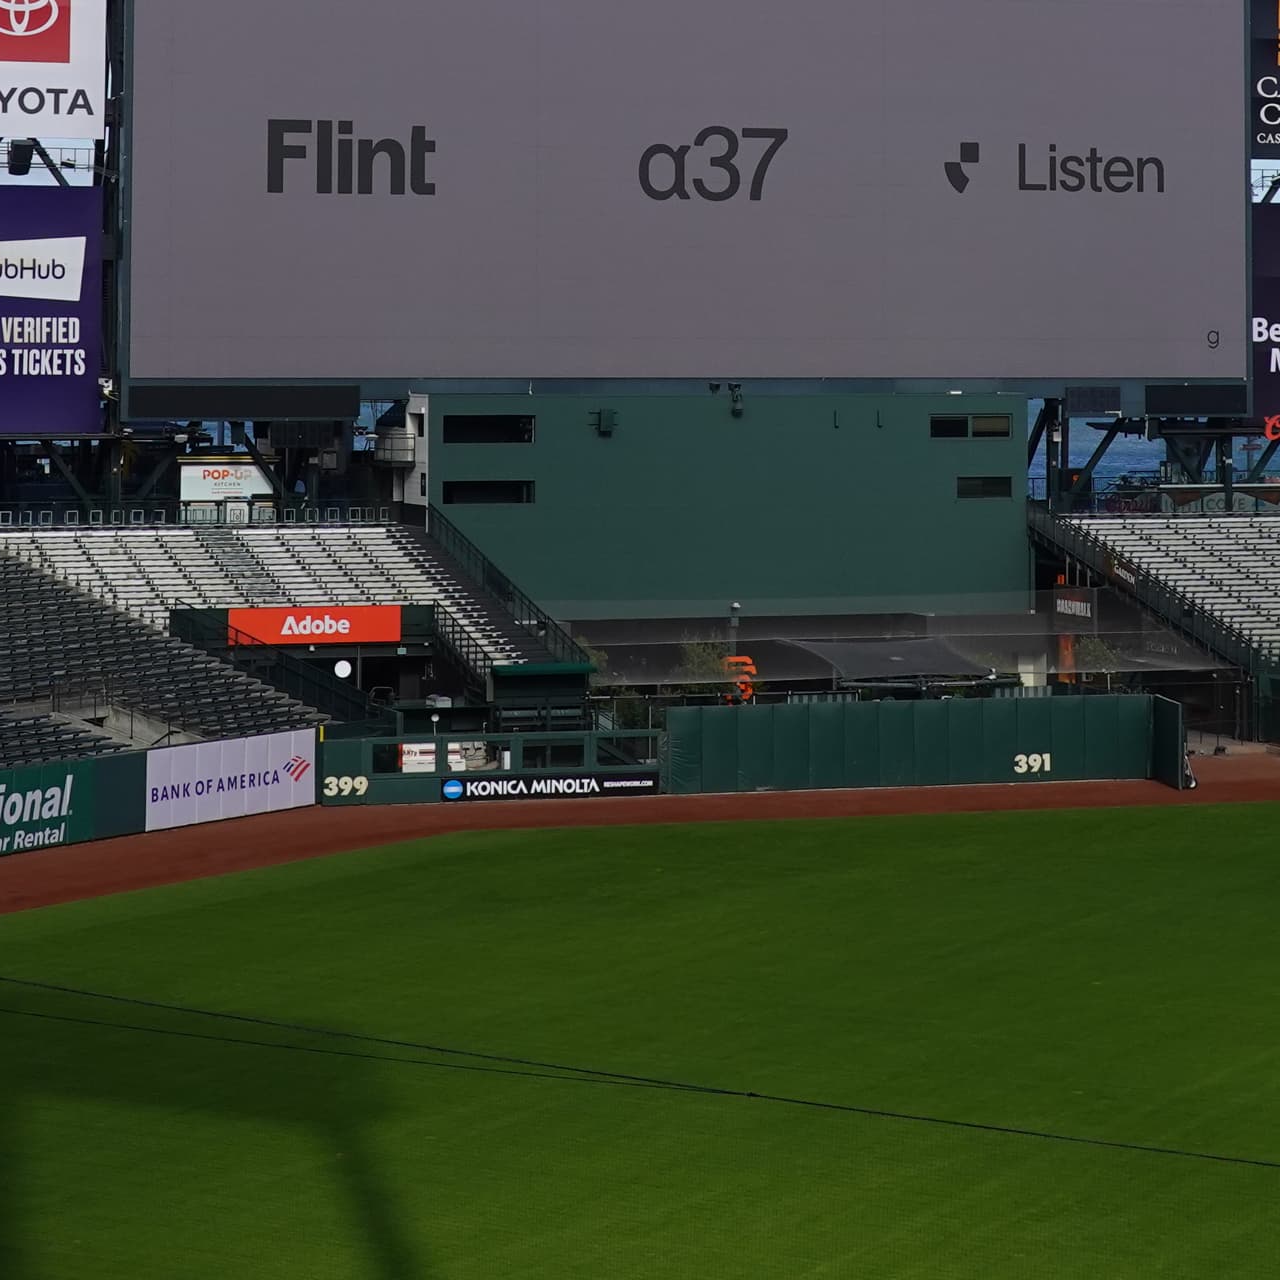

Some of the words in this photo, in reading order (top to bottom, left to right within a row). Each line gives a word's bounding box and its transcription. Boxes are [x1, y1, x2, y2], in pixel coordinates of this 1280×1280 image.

[266, 119, 436, 195] Flint
[1018, 143, 1166, 194] Listen
[0, 317, 80, 344] VERIFIED
[1206, 328, 1220, 349] g
[12, 349, 86, 376] TICKETS
[280, 615, 350, 635] Adobe
[1014, 753, 1052, 774] 391
[151, 783, 191, 804] BANK
[195, 779, 214, 796] OF
[216, 770, 281, 793] AMERICA
[323, 775, 369, 797] 399
[466, 780, 527, 797] KONICA
[531, 778, 600, 795] MINOLTA
[14, 823, 65, 851] Rental
